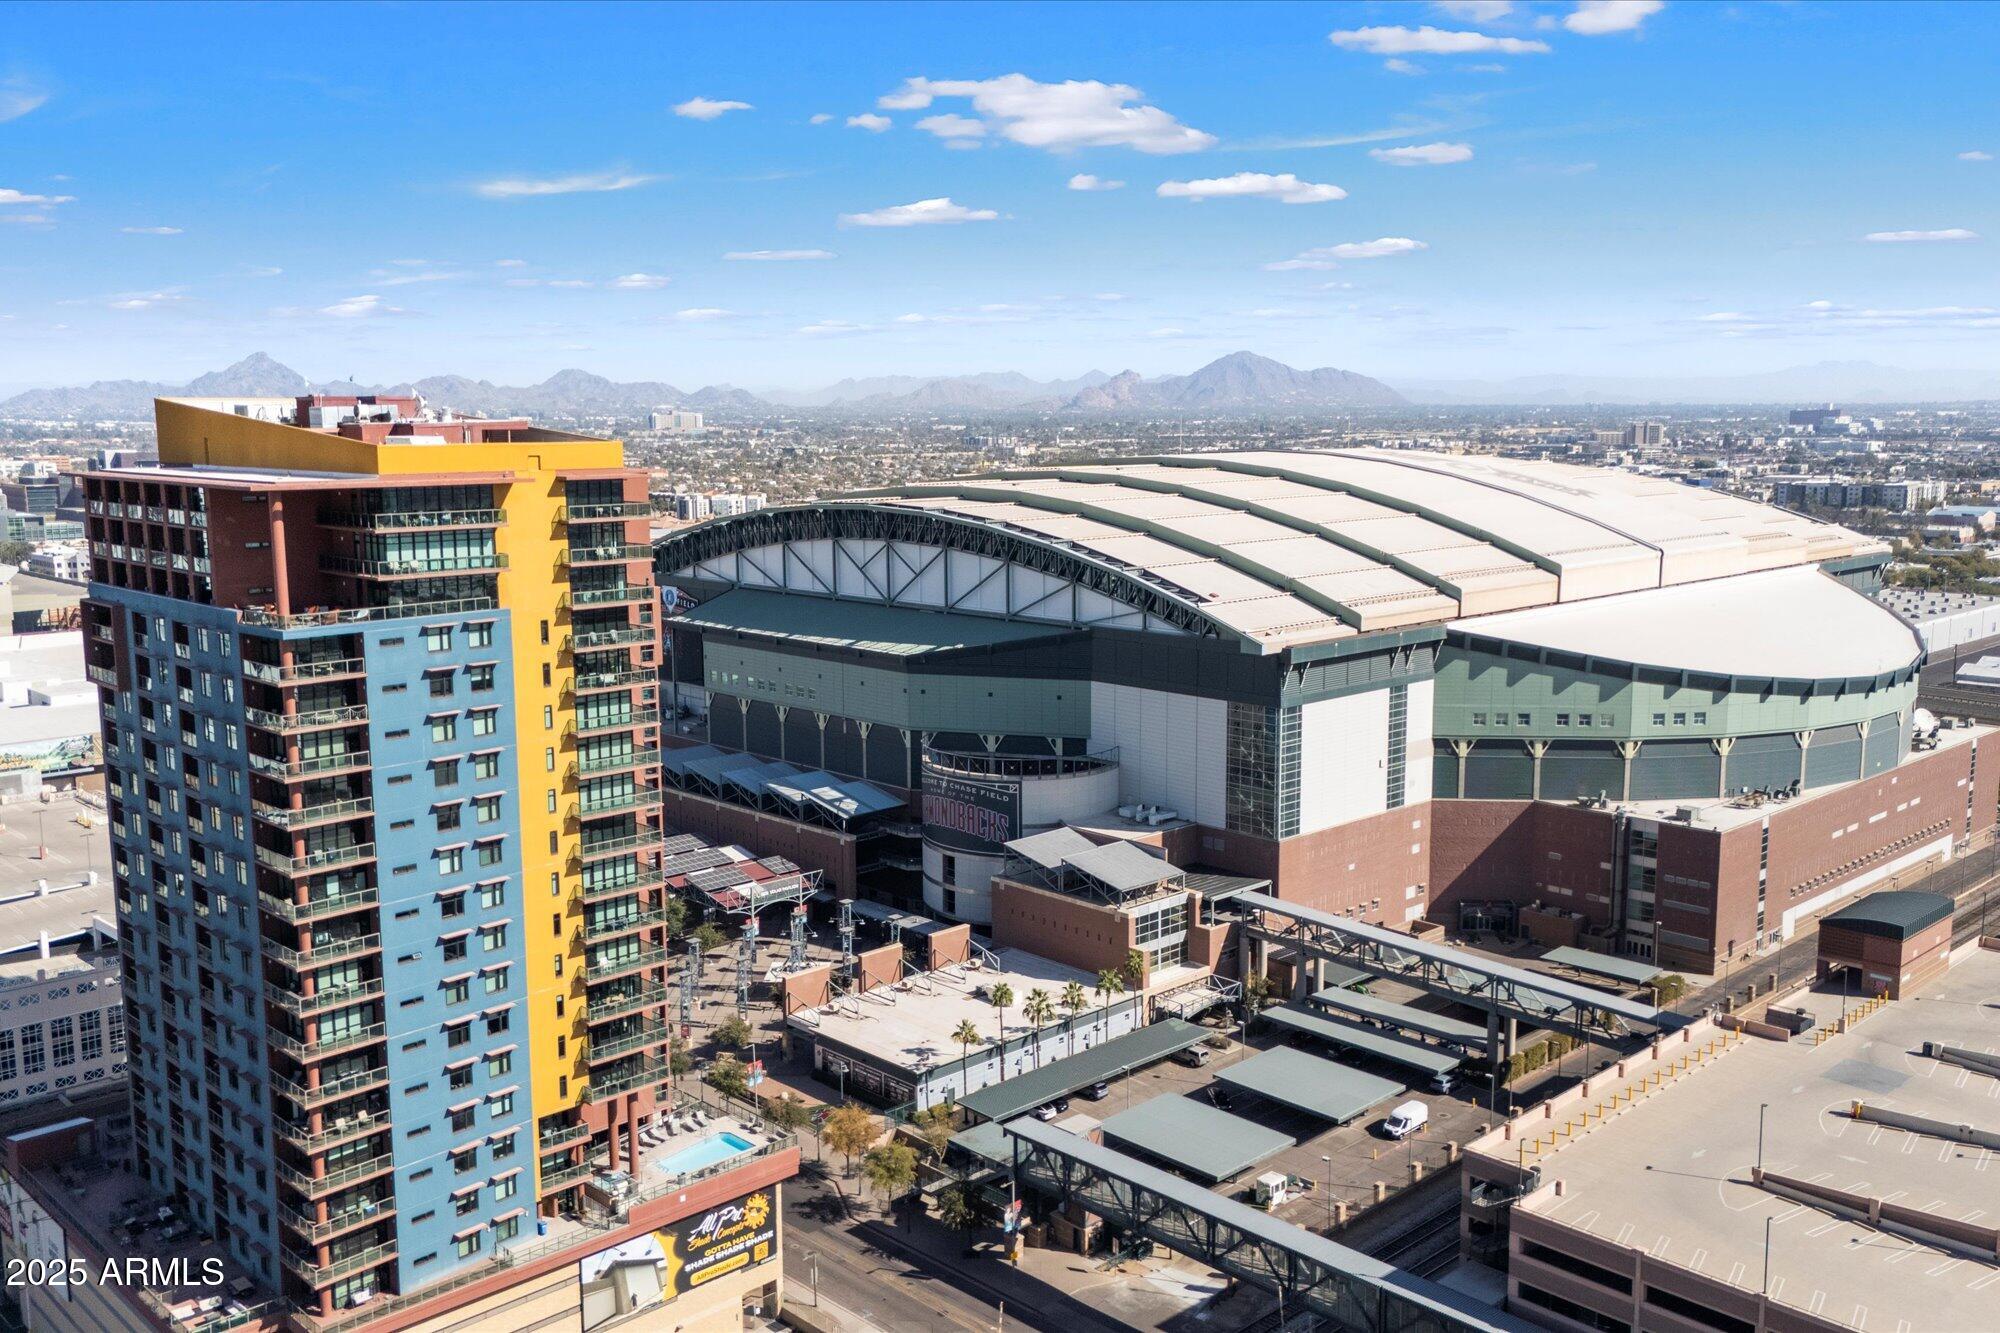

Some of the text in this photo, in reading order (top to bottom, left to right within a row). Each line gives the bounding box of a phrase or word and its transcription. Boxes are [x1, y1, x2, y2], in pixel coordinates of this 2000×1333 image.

[949, 783, 977, 794] CHASE
[980, 790, 1009, 802] FIELD
[960, 794, 975, 802] THE
[688, 1206, 745, 1242] All Pro
[684, 1254, 715, 1272] SHADE
[715, 1241, 746, 1260] SHADE
[745, 1230, 774, 1247] SHADE
[704, 1231, 755, 1257] GOTTA HAVE
